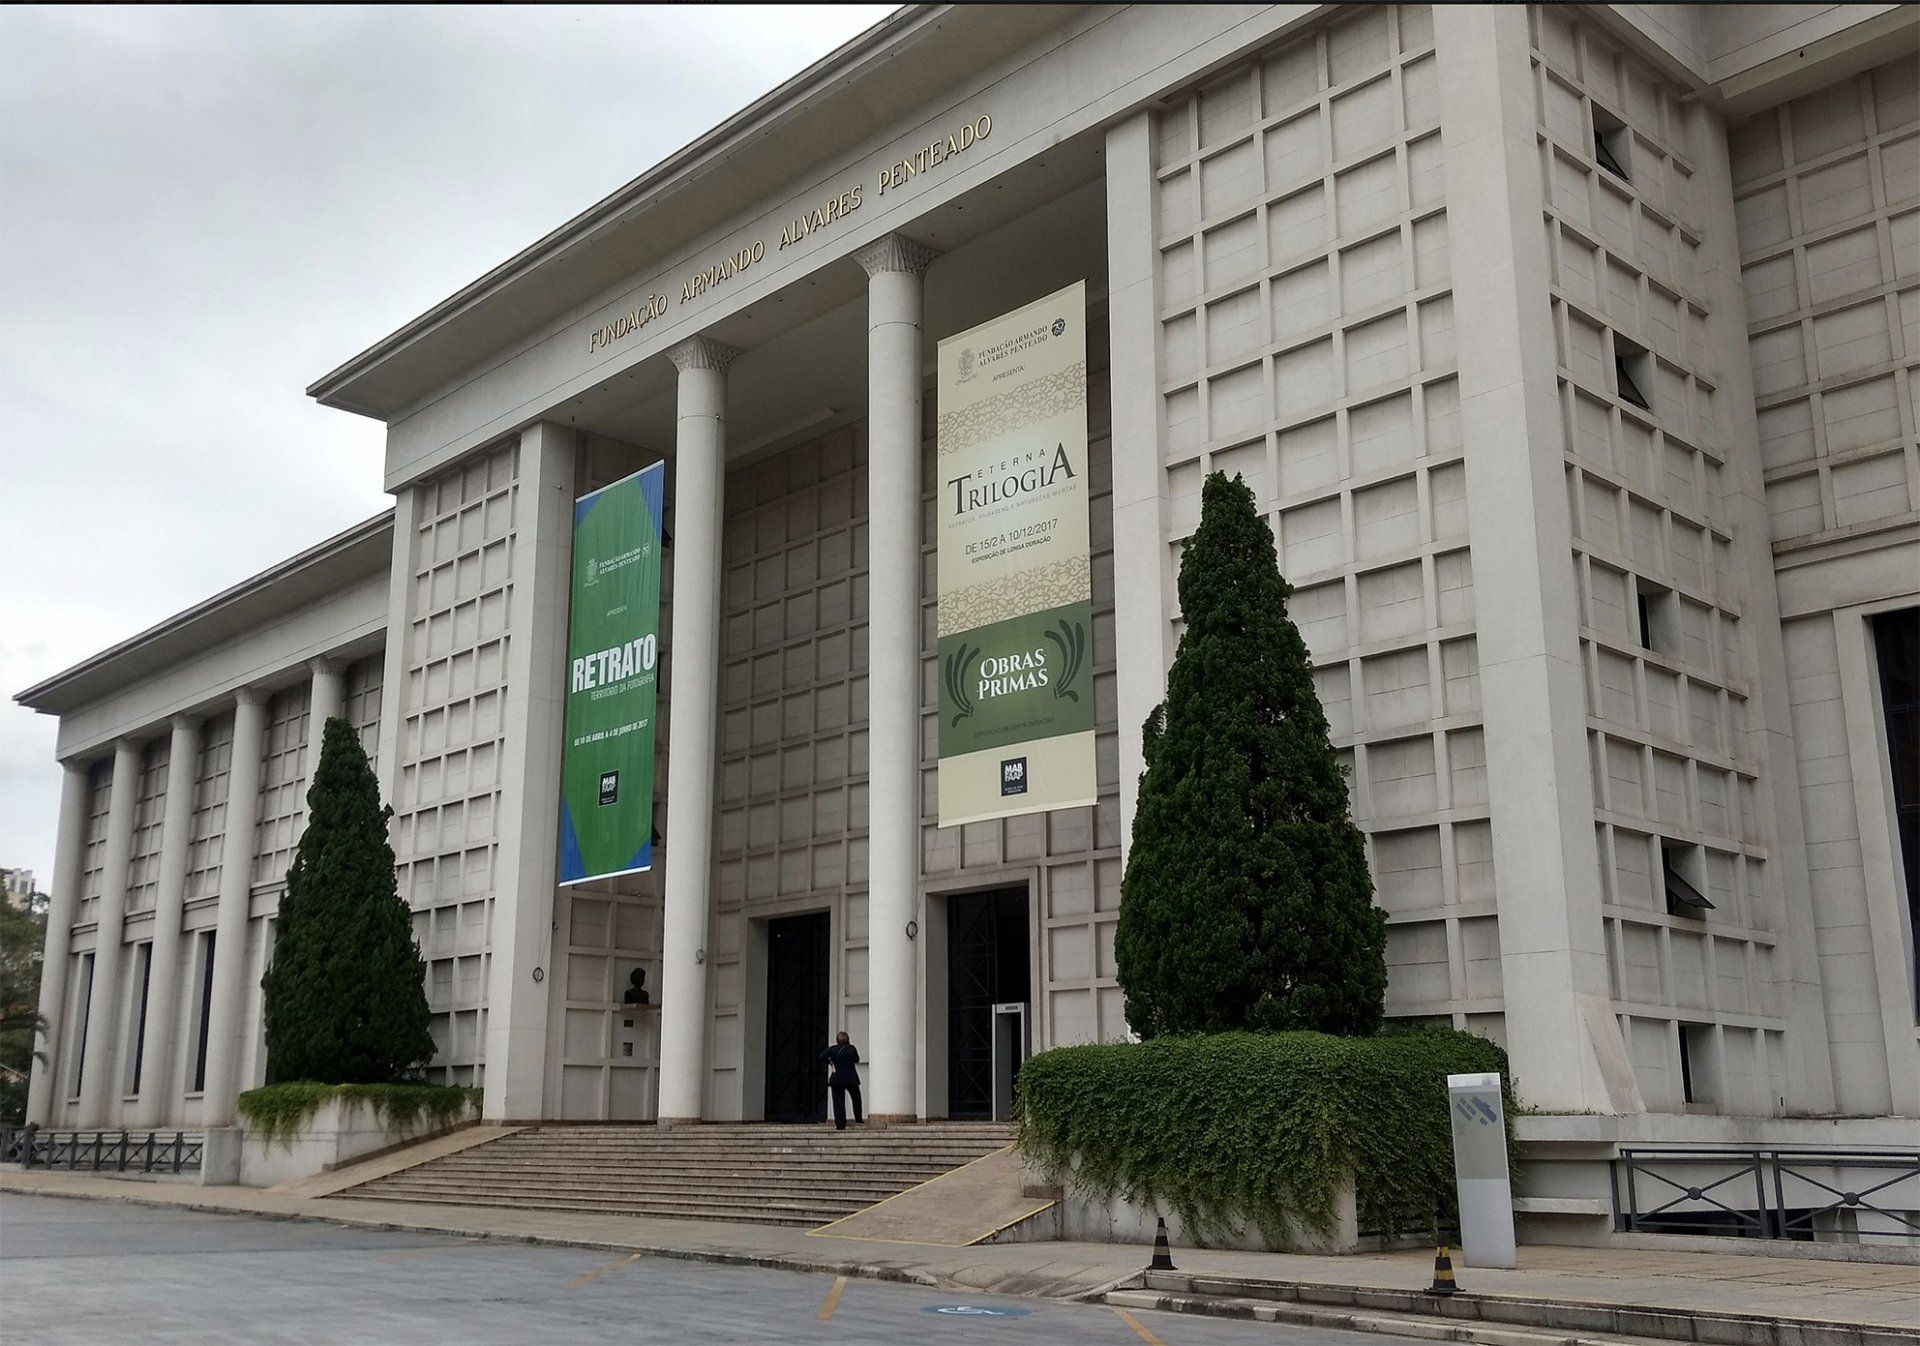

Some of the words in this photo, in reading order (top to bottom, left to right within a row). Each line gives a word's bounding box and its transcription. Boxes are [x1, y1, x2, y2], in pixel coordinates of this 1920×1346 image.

[589, 294, 668, 353] FUNDAÇÃO
[680, 240, 765, 304] ARMANDO
[779, 185, 862, 250] ALVARES
[878, 115, 992, 195] PENTEADO
[978, 339, 1013, 359] FUNDAÇÃO
[1015, 325, 1048, 344] ARMANDO
[979, 350, 1009, 367] ALVARES
[1010, 334, 1048, 355] PENTEADO
[977, 448, 1046, 479] ETERNA
[965, 542, 977, 555] DE
[980, 536, 998, 550] 15/2
[1000, 534, 1006, 544] A
[1009, 518, 1058, 541] 10/12/2017
[972, 551, 999, 564] EXPOSIÇÃO
[1000, 548, 1005, 556] DE
[1007, 543, 1024, 553] LONGA
[1025, 535, 1051, 548] DURAÇÃO
[572, 633, 656, 694] RETRATO
[980, 648, 1046, 679] OBRAS
[978, 668, 1048, 700] PRIMAS
[592, 731, 604, 741] ABRIL
[1005, 762, 1023, 772] MAB
